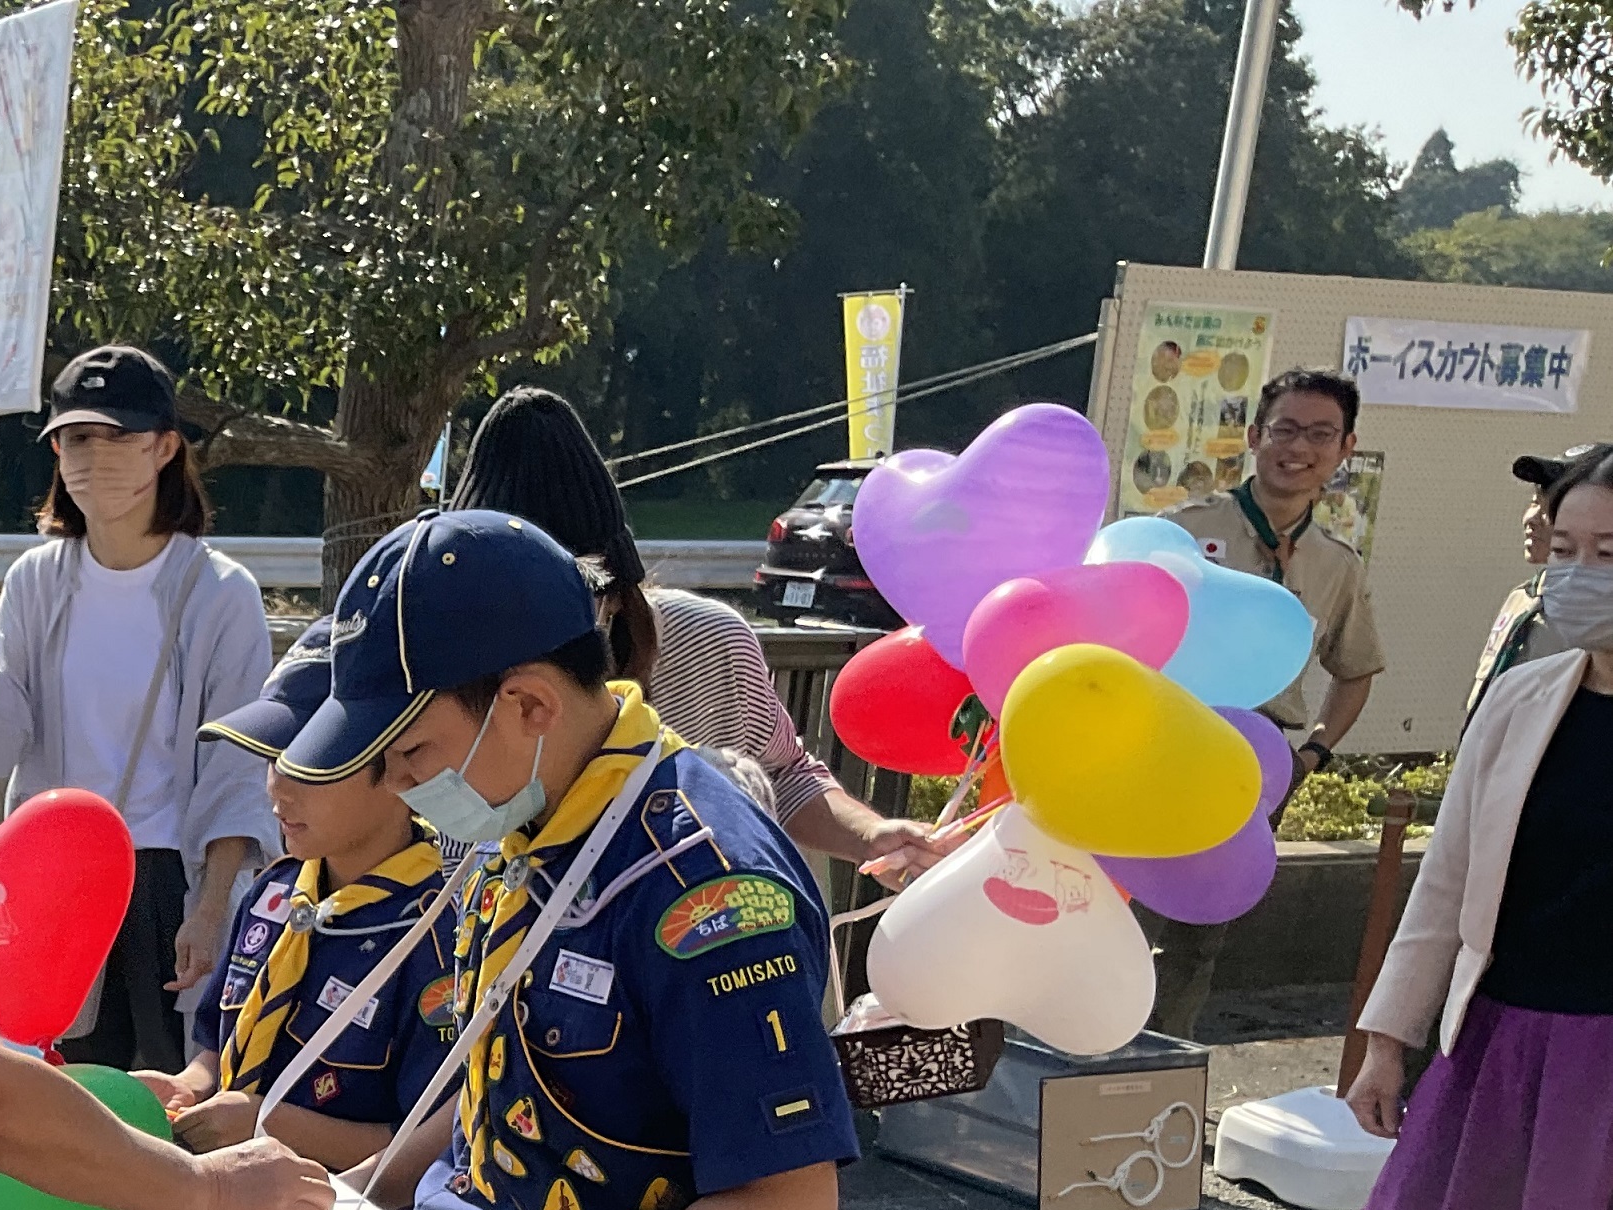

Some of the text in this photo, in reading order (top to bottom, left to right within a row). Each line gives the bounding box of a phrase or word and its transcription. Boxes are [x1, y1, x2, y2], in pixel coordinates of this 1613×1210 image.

[1347, 335, 1574, 390] ボーイスカウト募集中
[696, 914, 729, 937] ちば
[707, 955, 797, 996] TOMISATO
[766, 1009, 787, 1052] 1
